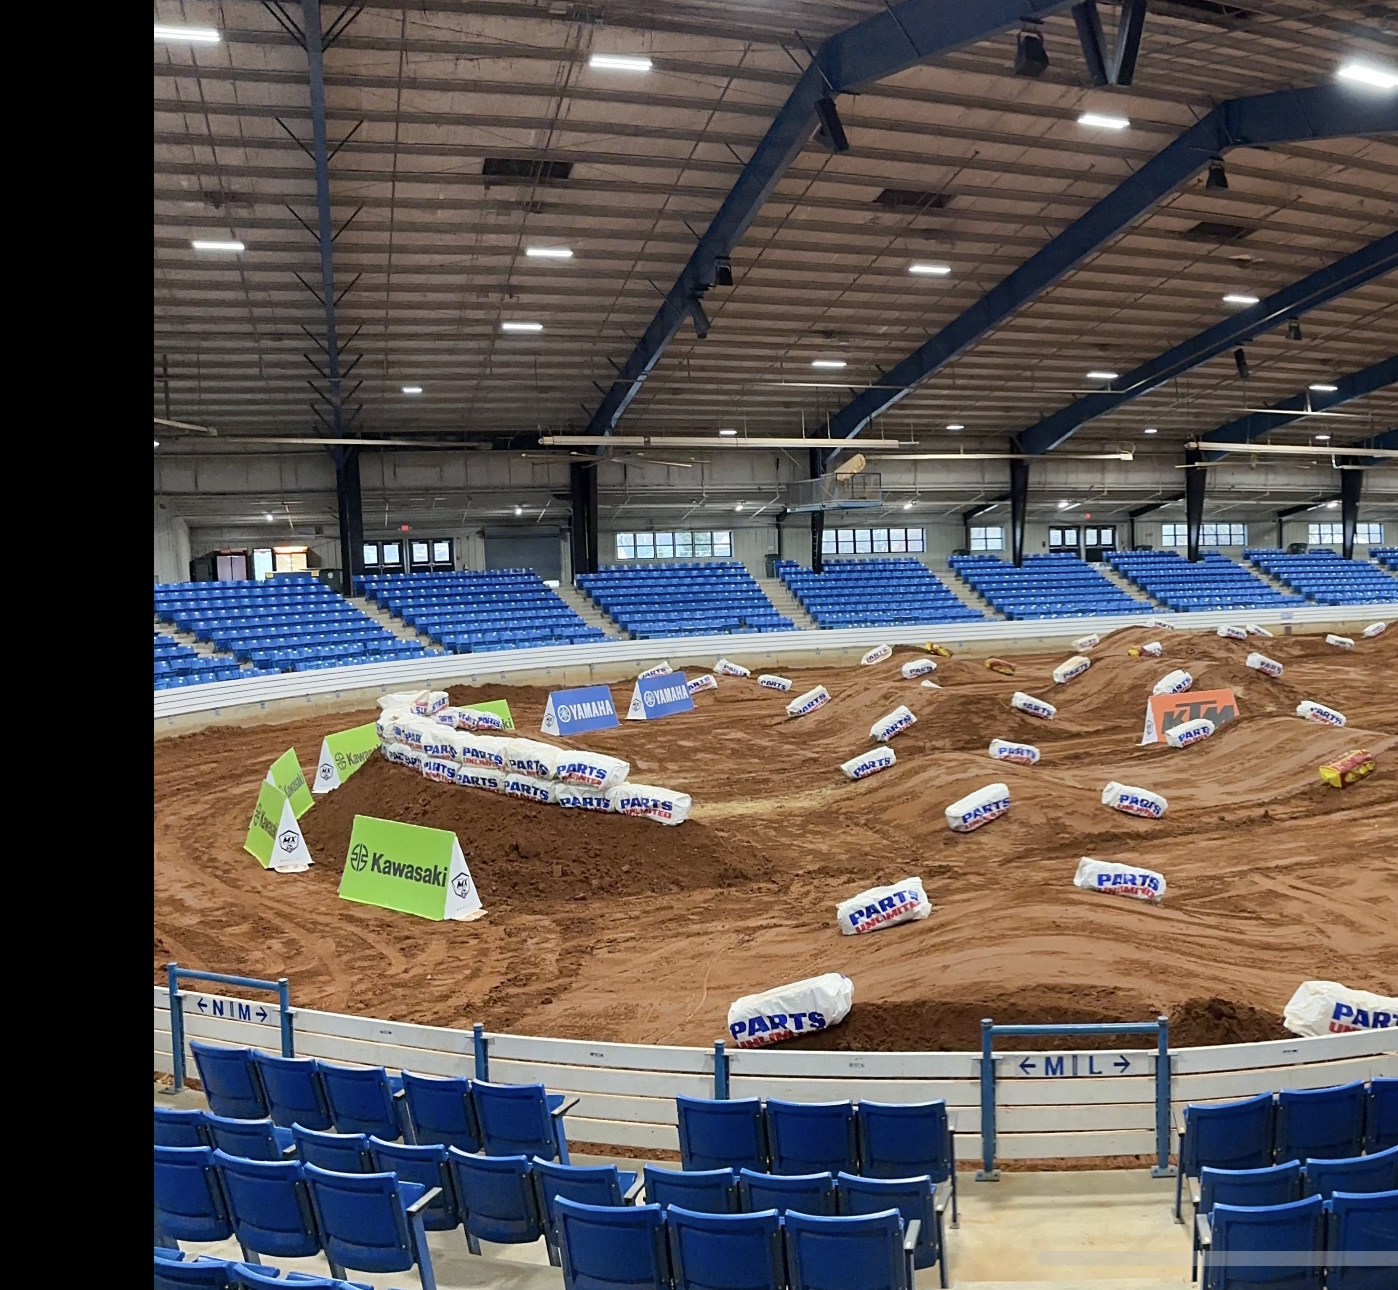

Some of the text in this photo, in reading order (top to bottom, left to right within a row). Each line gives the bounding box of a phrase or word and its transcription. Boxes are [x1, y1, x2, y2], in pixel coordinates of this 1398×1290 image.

[653, 684, 690, 705] YAMAHA
[569, 699, 614, 720] YAMAHA
[1161, 700, 1235, 734] KTM
[557, 763, 608, 779] PARTS
[854, 757, 891, 777] PARTS
[505, 781, 550, 801] PARTS
[560, 796, 610, 809] PARTS
[620, 798, 673, 811] PARTS
[962, 798, 1009, 823] PARTS
[371, 852, 448, 888] Kawasaki
[1097, 873, 1160, 892] PARTS
[849, 890, 919, 926] PARTS
[730, 1011, 826, 1040] PARTS
